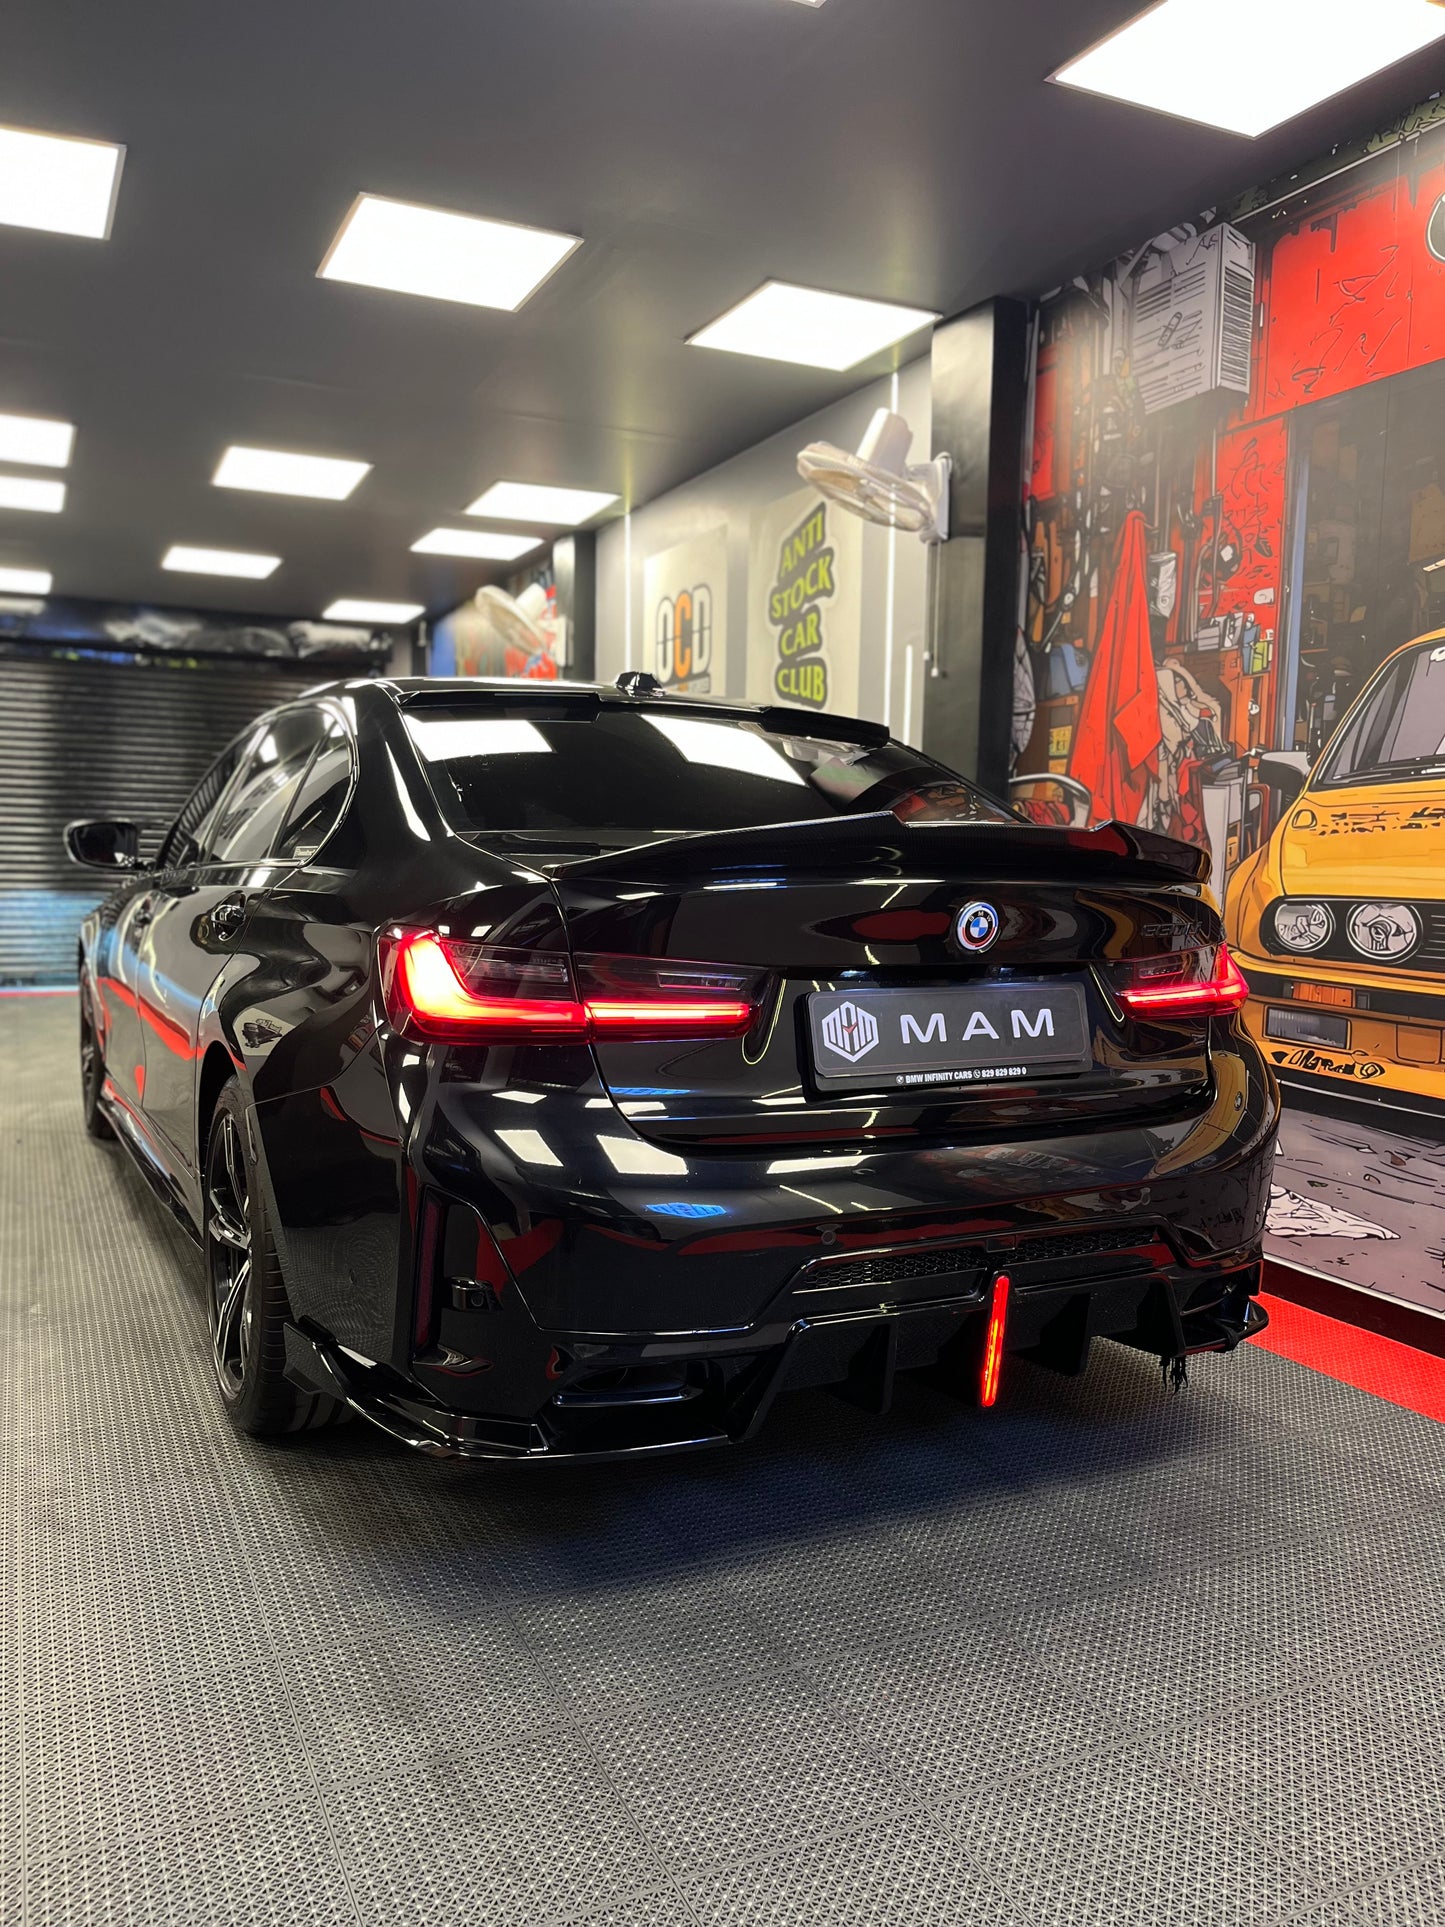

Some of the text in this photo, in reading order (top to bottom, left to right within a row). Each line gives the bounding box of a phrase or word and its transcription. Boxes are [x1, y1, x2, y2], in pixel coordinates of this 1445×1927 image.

[780, 511, 824, 578] ANTI
[771, 555, 832, 619] STOCK
[656, 584, 712, 684] OCD
[780, 612, 820, 656] CAR
[777, 665, 825, 702] CLUB
[968, 910, 993, 922] BMW
[900, 1008, 1055, 1044] MAM
[905, 1066, 1027, 1083] BMW INFINITY CARS 829 829 829 0
